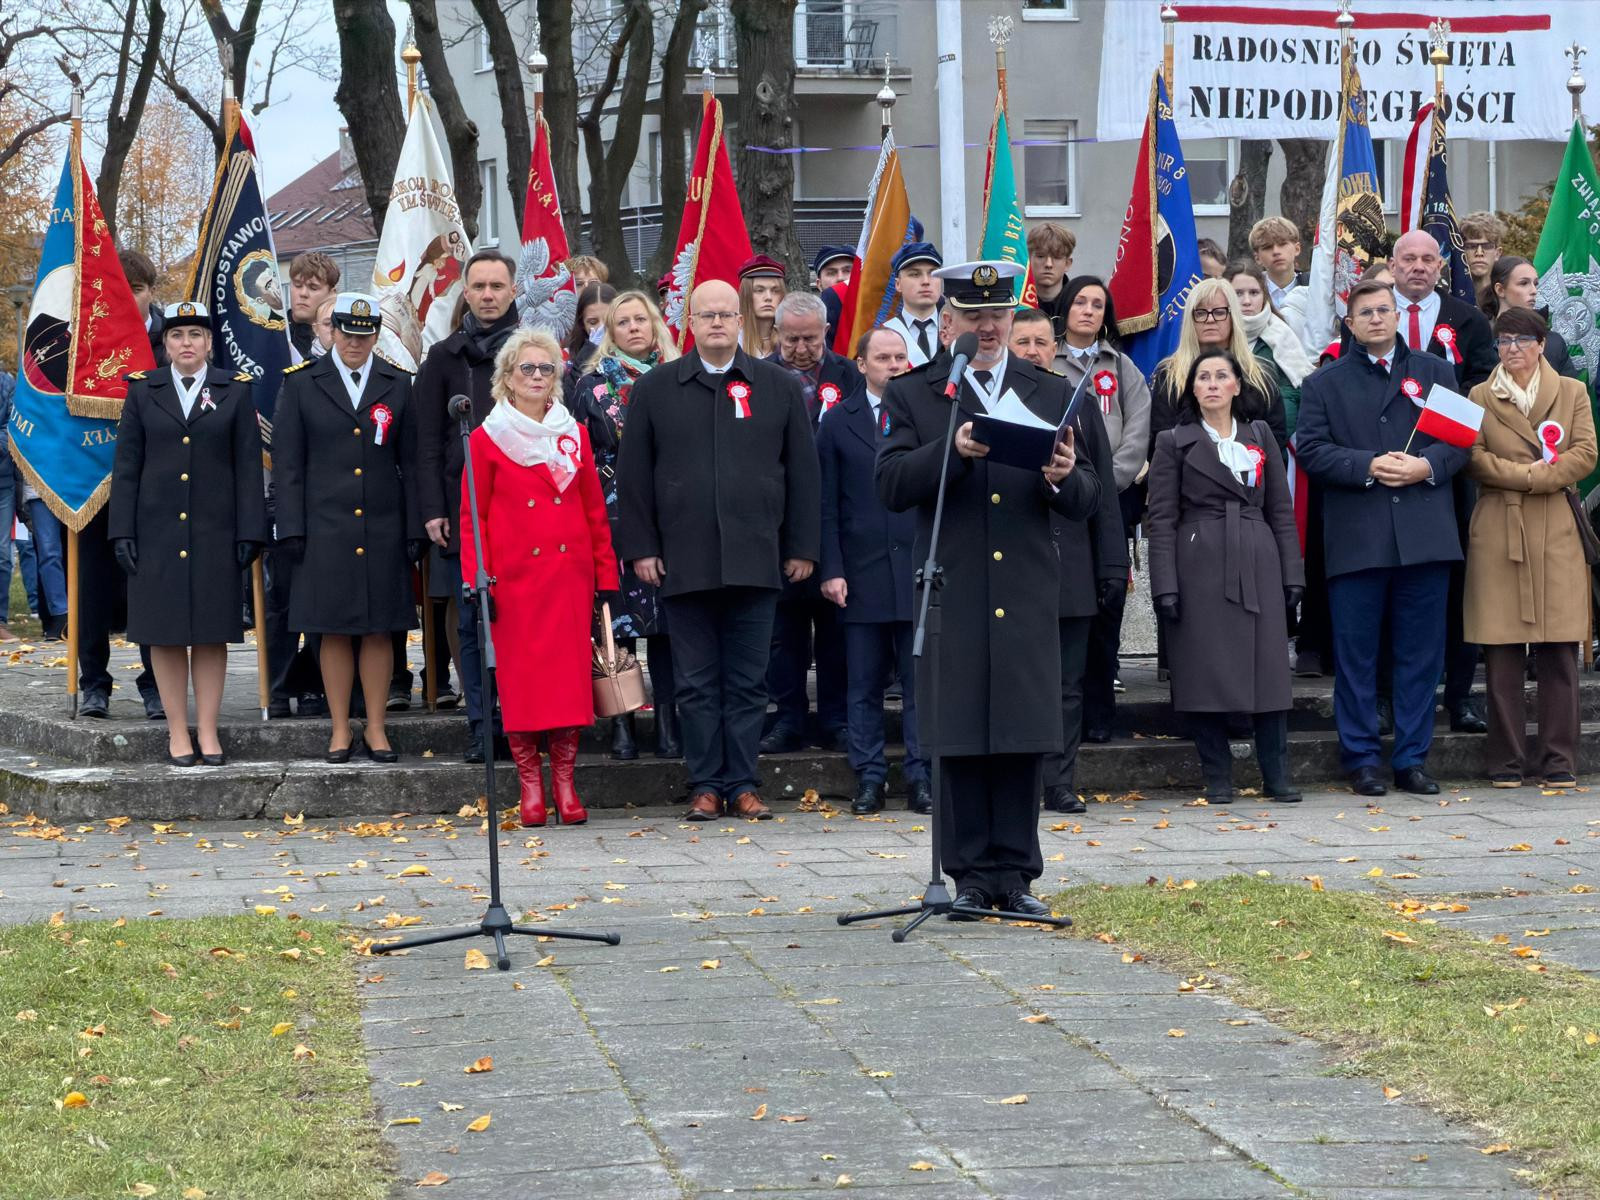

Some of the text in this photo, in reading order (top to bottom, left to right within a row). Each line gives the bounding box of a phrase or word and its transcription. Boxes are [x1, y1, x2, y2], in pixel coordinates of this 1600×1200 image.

[1157, 152, 1186, 180] NR 8
[215, 215, 268, 316] PODSTAWO
